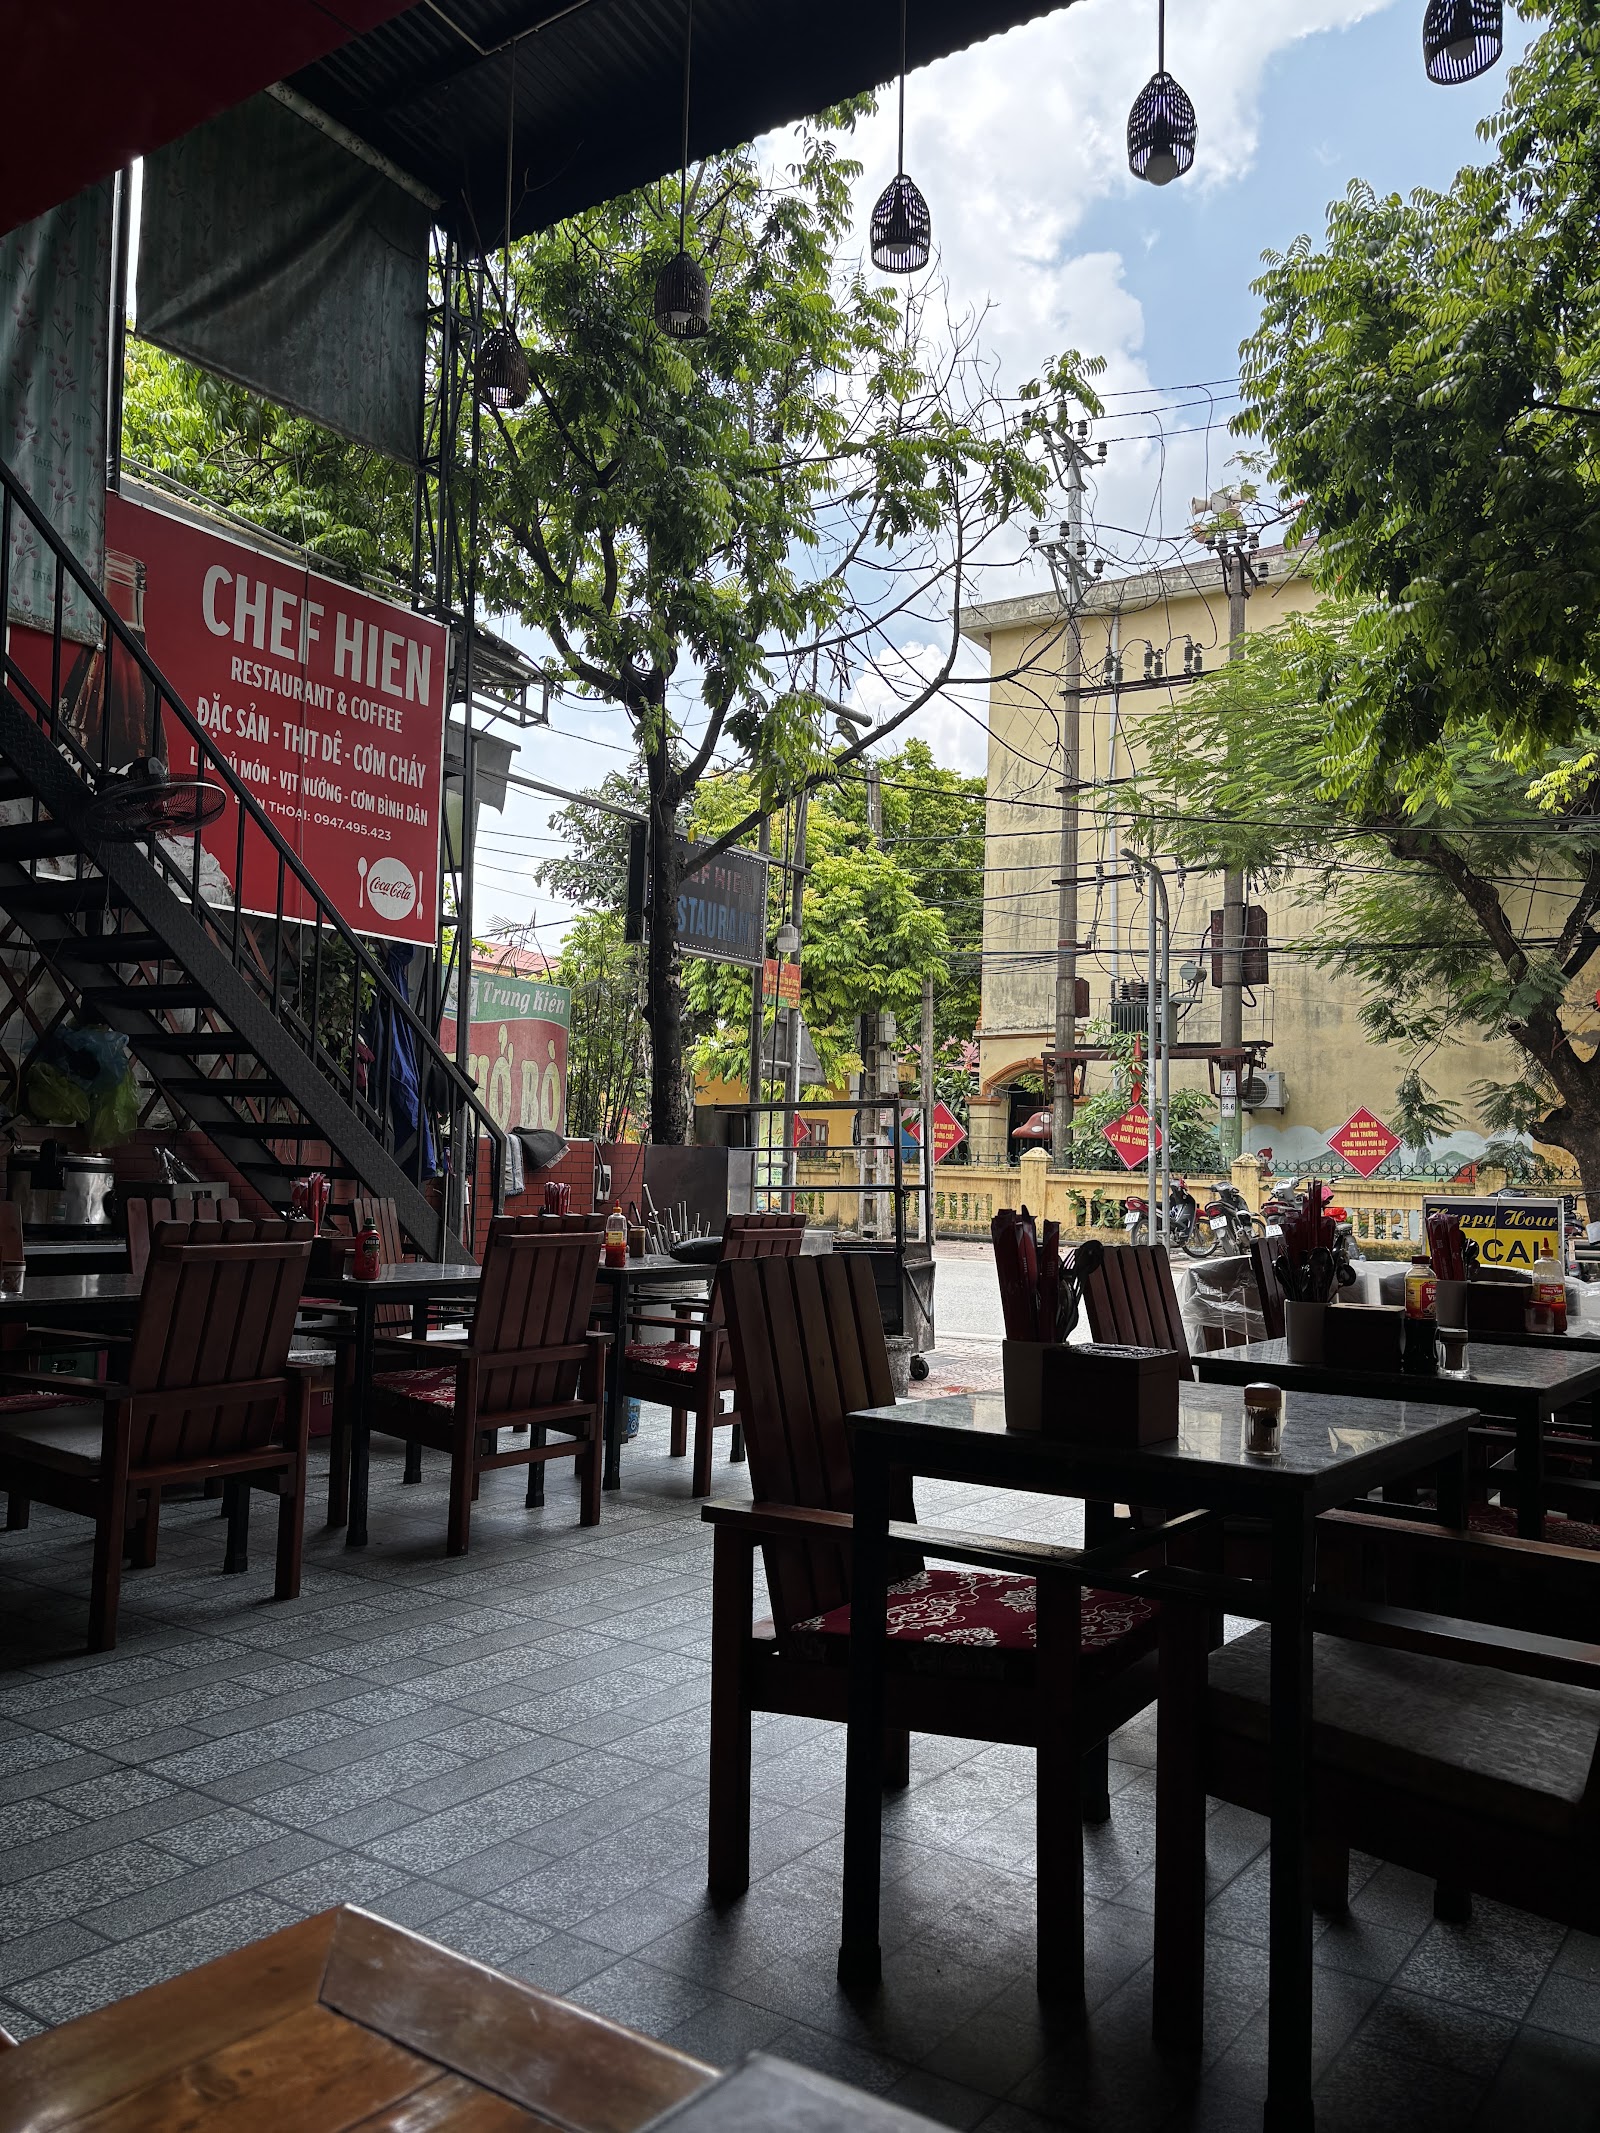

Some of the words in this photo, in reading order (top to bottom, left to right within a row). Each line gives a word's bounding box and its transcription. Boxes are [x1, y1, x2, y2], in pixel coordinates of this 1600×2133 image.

[203, 564, 325, 665] CHEF
[334, 611, 432, 707] HIEN
[231, 656, 334, 711] RESTAURANT
[337, 691, 347, 716] &
[351, 697, 403, 733] COFFEE
[197, 692, 232, 738] ĐẶC
[236, 702, 269, 744] SẢN
[282, 722, 319, 763] THỊT
[321, 730, 342, 765] DÊ
[353, 743, 386, 777] CƠM
[389, 753, 426, 788] CHÁY
[241, 758, 270, 784] MÓN
[280, 769, 299, 795] VỊT
[301, 776, 342, 803] NƯỚNG
[350, 789, 375, 812] CƠM
[377, 793, 404, 820] BÌNH
[406, 803, 428, 826] DÂN
[314, 812, 391, 841] 0947.495.423
[483, 980, 530, 1015] Trung
[532, 989, 566, 1015] Kiên
[1504, 1209, 1558, 1227] Hour
